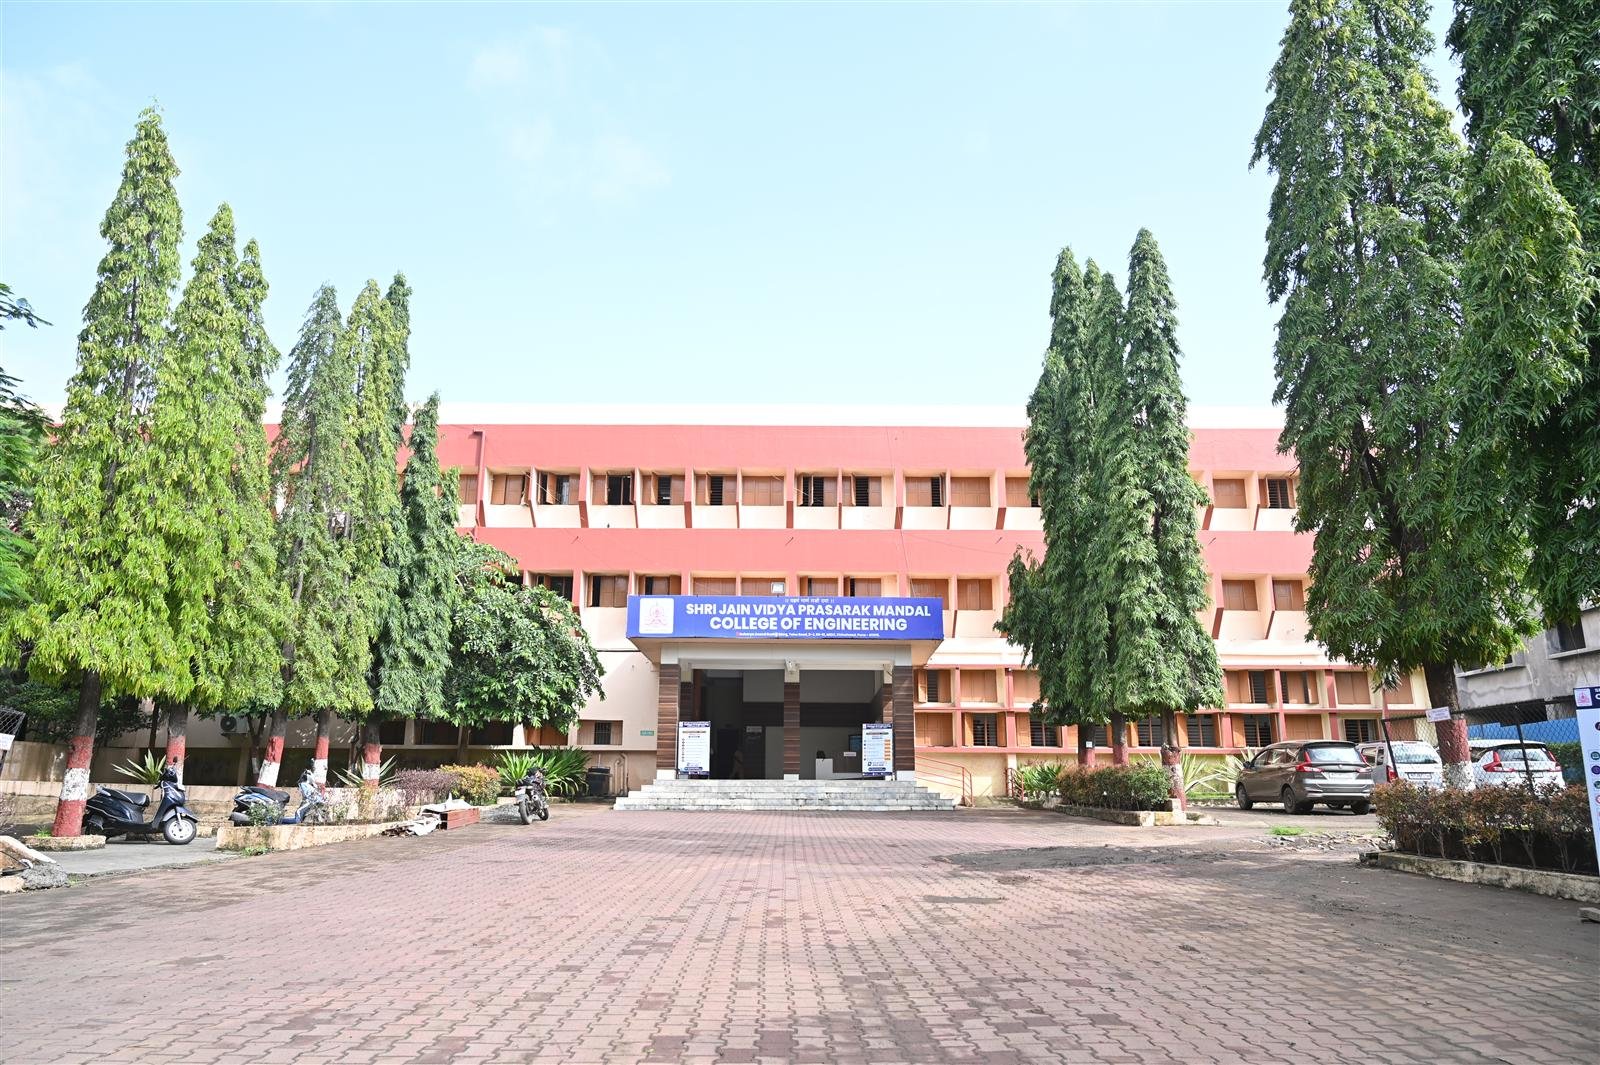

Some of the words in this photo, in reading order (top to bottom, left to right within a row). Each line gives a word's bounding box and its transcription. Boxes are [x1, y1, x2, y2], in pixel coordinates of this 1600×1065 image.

[686, 603, 716, 615] SHRI
[719, 603, 750, 616] JAIN
[753, 604, 795, 616] VIDYA
[798, 605, 870, 616] PRASARAK
[873, 605, 931, 617] MANDAL
[709, 617, 778, 630] COLLEGE
[780, 618, 801, 630] OF
[804, 618, 908, 631] ENGINEERING
